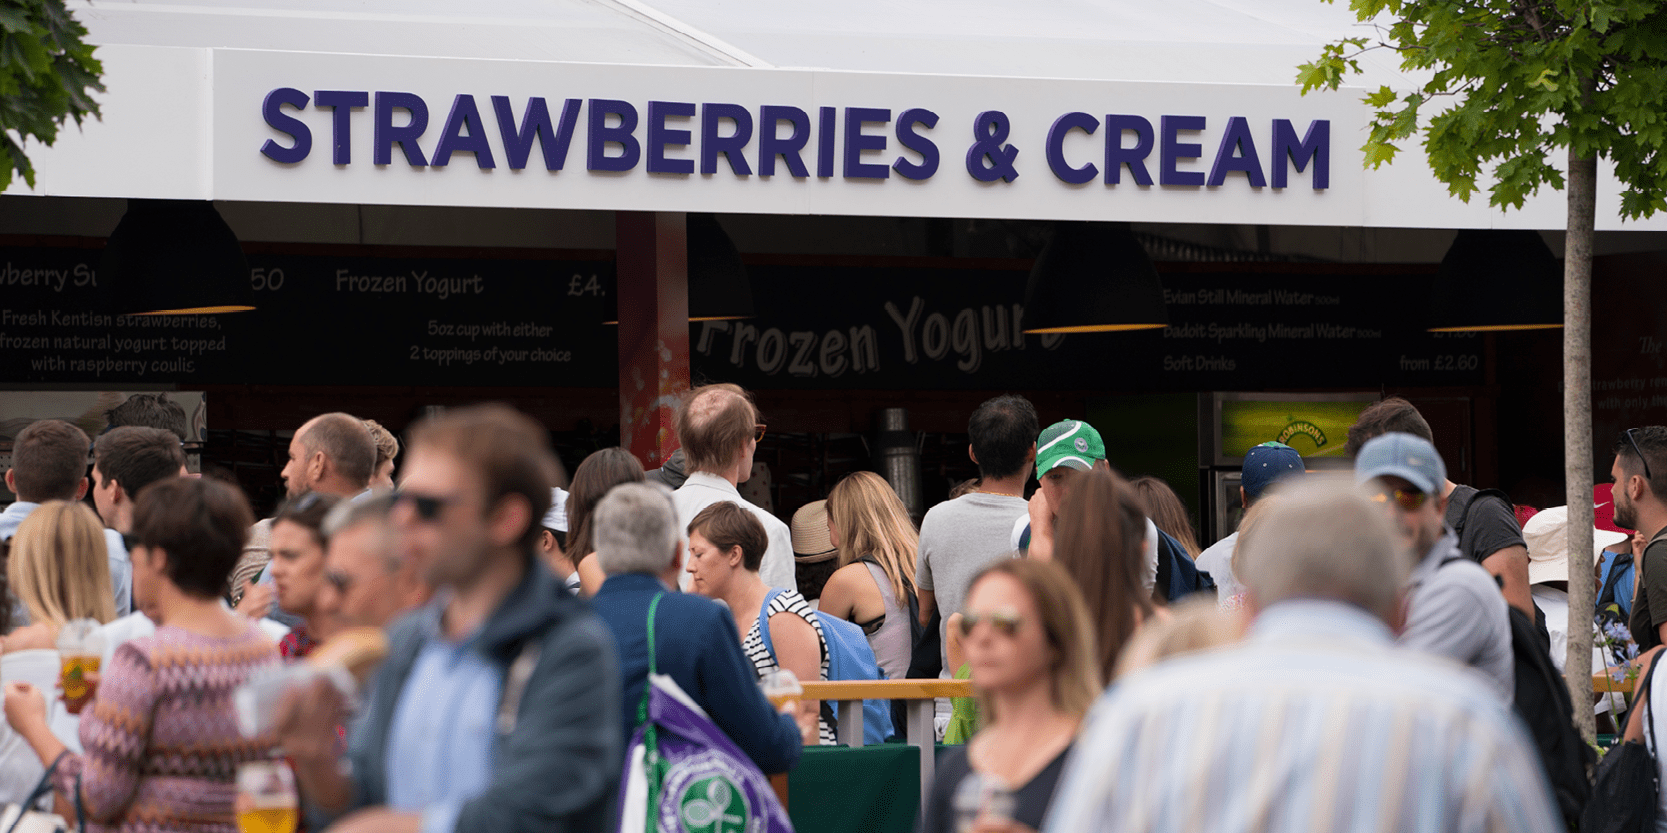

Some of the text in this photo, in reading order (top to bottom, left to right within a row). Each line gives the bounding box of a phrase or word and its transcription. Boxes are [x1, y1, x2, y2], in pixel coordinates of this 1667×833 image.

[260, 86, 1331, 194] STRAWBERRIES & CREAM
[336, 268, 484, 299] Frozen Yogurt
[1162, 288, 1196, 305] Evian
[1197, 288, 1225, 305] Still
[1227, 288, 1273, 305] Mineral
[1273, 288, 1315, 306] Water
[2, 308, 47, 327] Fresh
[427, 319, 554, 342] 5oz cup with either
[1207, 322, 1267, 345] Sparkling
[1267, 322, 1315, 339] Mineral
[1315, 322, 1357, 339] Water
[0, 332, 226, 356] frozen natural yogurt topped
[1638, 336, 1663, 354] The
[30, 355, 196, 377] with raspberry coulis
[409, 345, 573, 367] 2 toppings of your choice
[1163, 354, 1237, 371] Soft Drinks
[1399, 354, 1479, 371] from £2.60
[1592, 376, 1646, 392] trawberry
[1624, 395, 1648, 411] only
[1279, 421, 1327, 445] ROBINSONS
